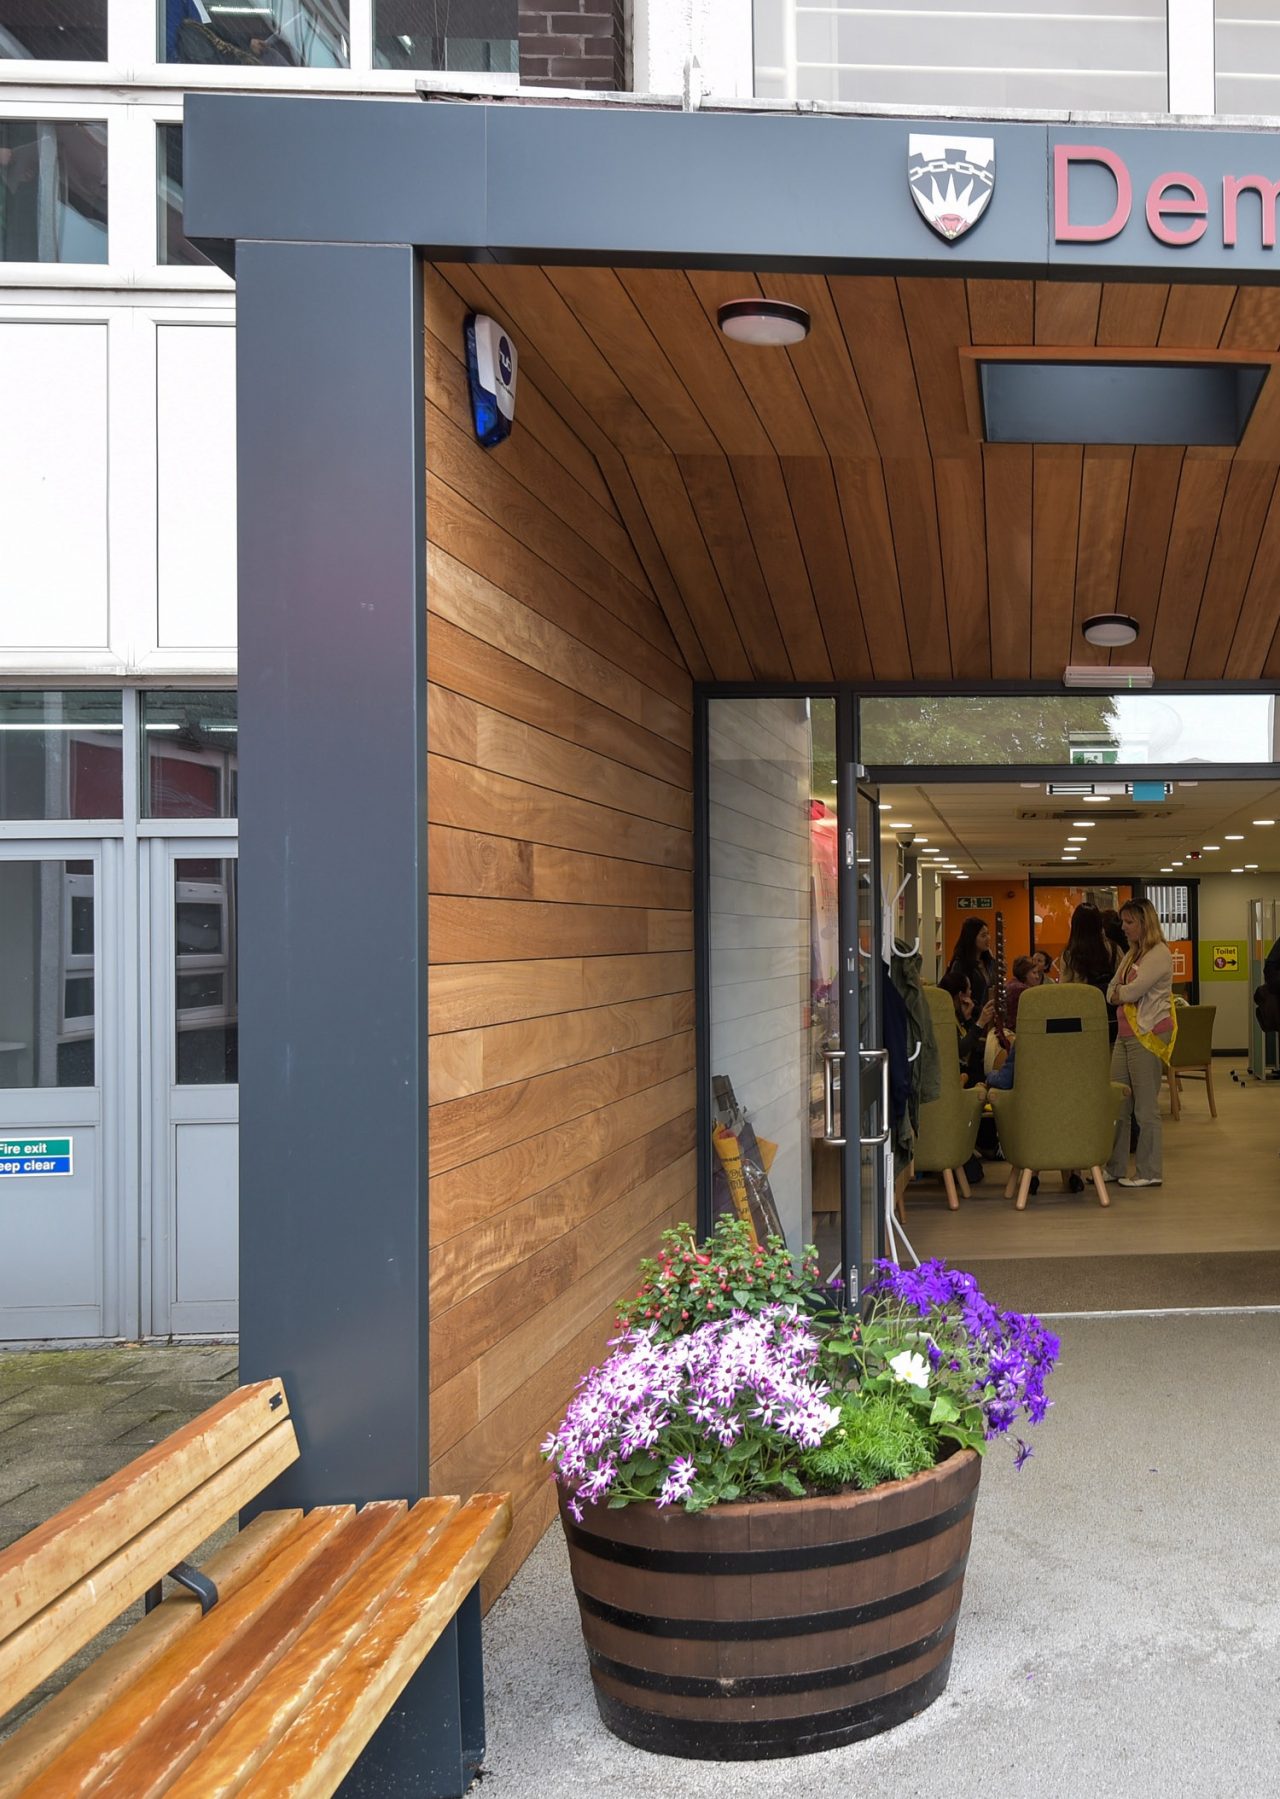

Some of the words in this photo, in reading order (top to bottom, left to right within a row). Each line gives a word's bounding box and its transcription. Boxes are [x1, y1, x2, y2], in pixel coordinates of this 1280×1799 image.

[24, 1143, 47, 1153] exit
[0, 1162, 20, 1173] eep
[23, 1160, 56, 1171] clear
